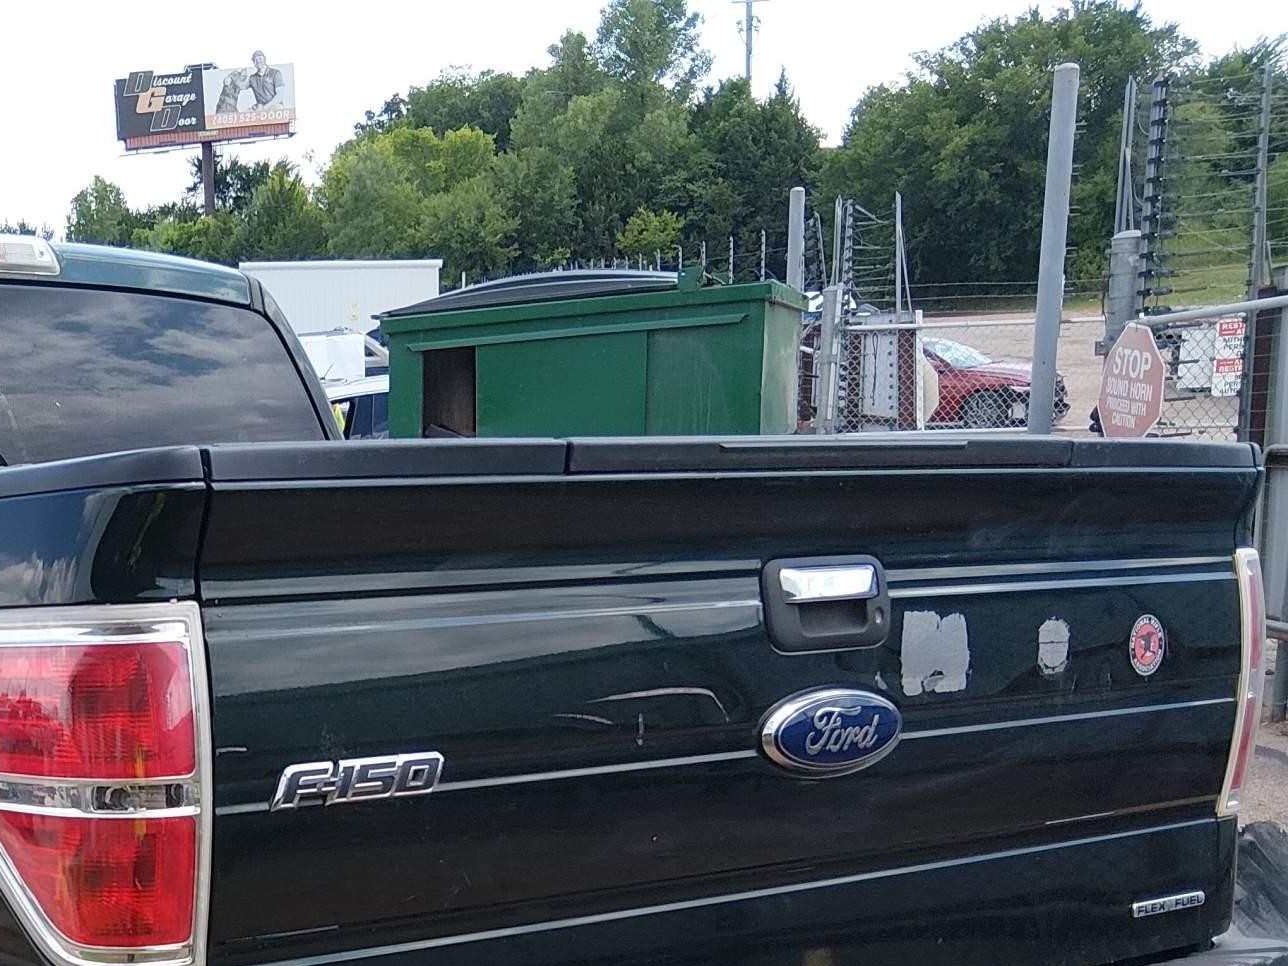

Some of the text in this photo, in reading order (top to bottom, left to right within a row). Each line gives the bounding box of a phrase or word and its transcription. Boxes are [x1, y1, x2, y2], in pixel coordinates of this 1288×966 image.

[123, 70, 192, 97] Discount
[136, 86, 197, 114] Garage
[150, 104, 197, 132] Door
[1112, 347, 1152, 379] STOP
[1106, 376, 1153, 401] SOUND HORN
[1105, 396, 1147, 416] PROCEED WITH
[1111, 411, 1136, 429] CAUTION
[805, 706, 880, 755] Ford
[270, 751, 445, 812] F-150
[1137, 894, 1203, 916] FLEX FUEL
